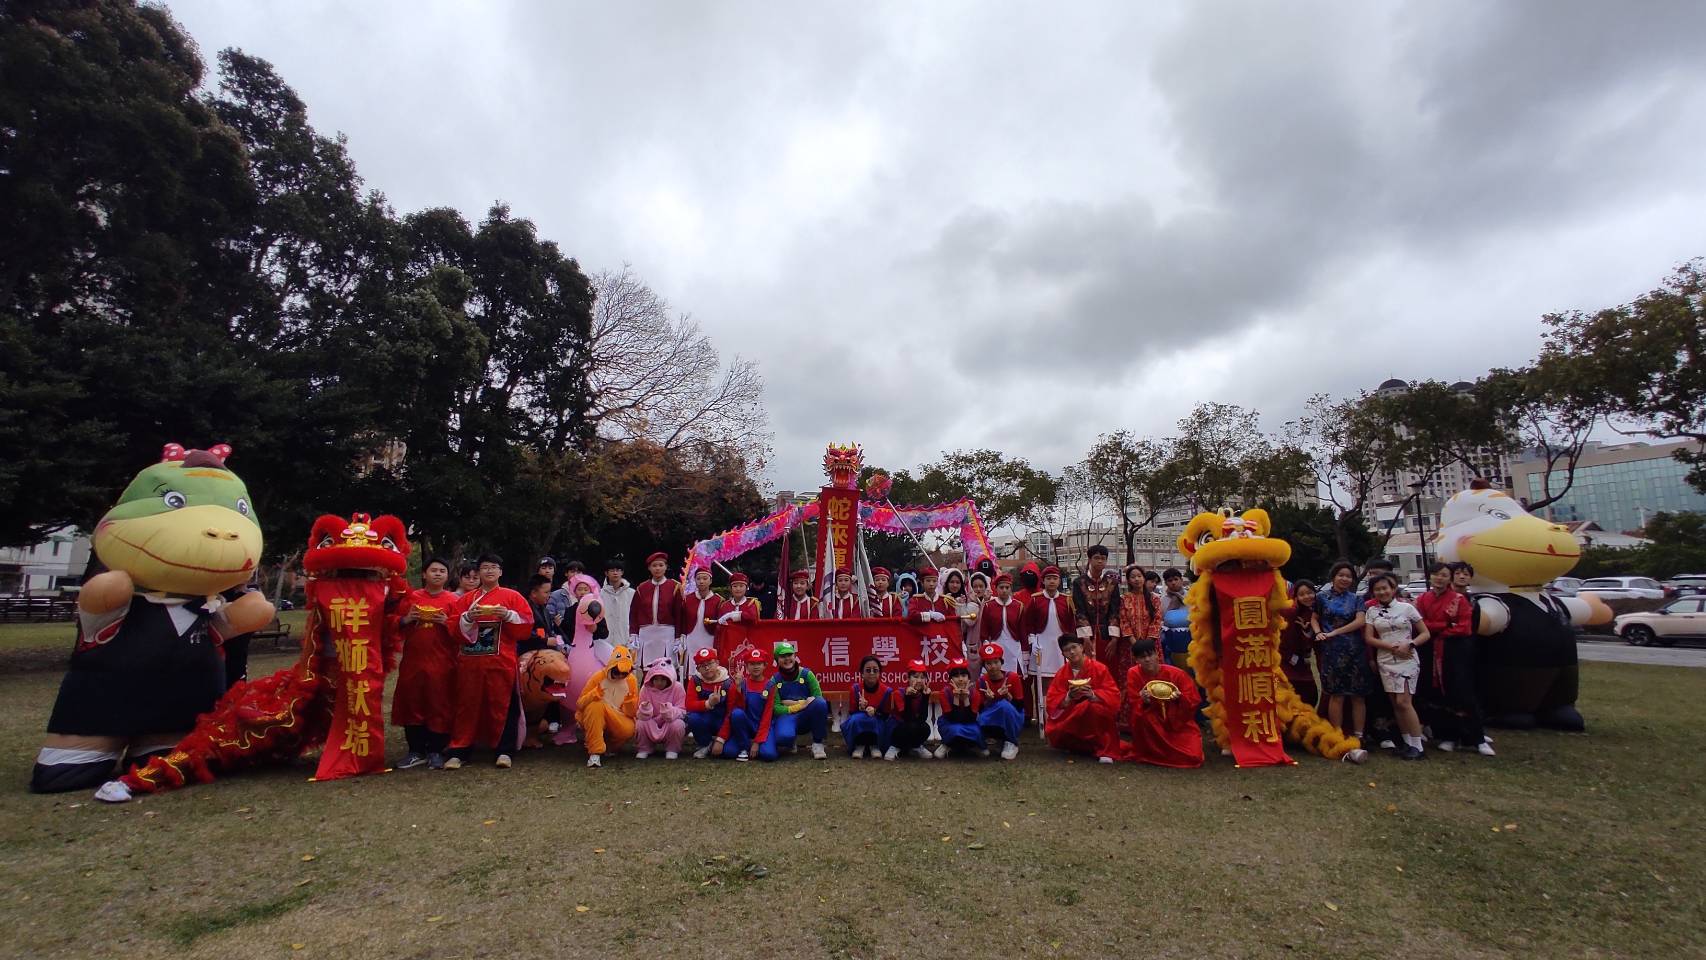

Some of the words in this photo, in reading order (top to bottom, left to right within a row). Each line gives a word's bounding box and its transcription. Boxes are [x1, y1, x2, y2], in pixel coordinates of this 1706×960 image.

[816, 671, 863, 683] CHUNG-H
[881, 671, 908, 683] SCHO
[1233, 596, 1279, 743] 圓滿順利
